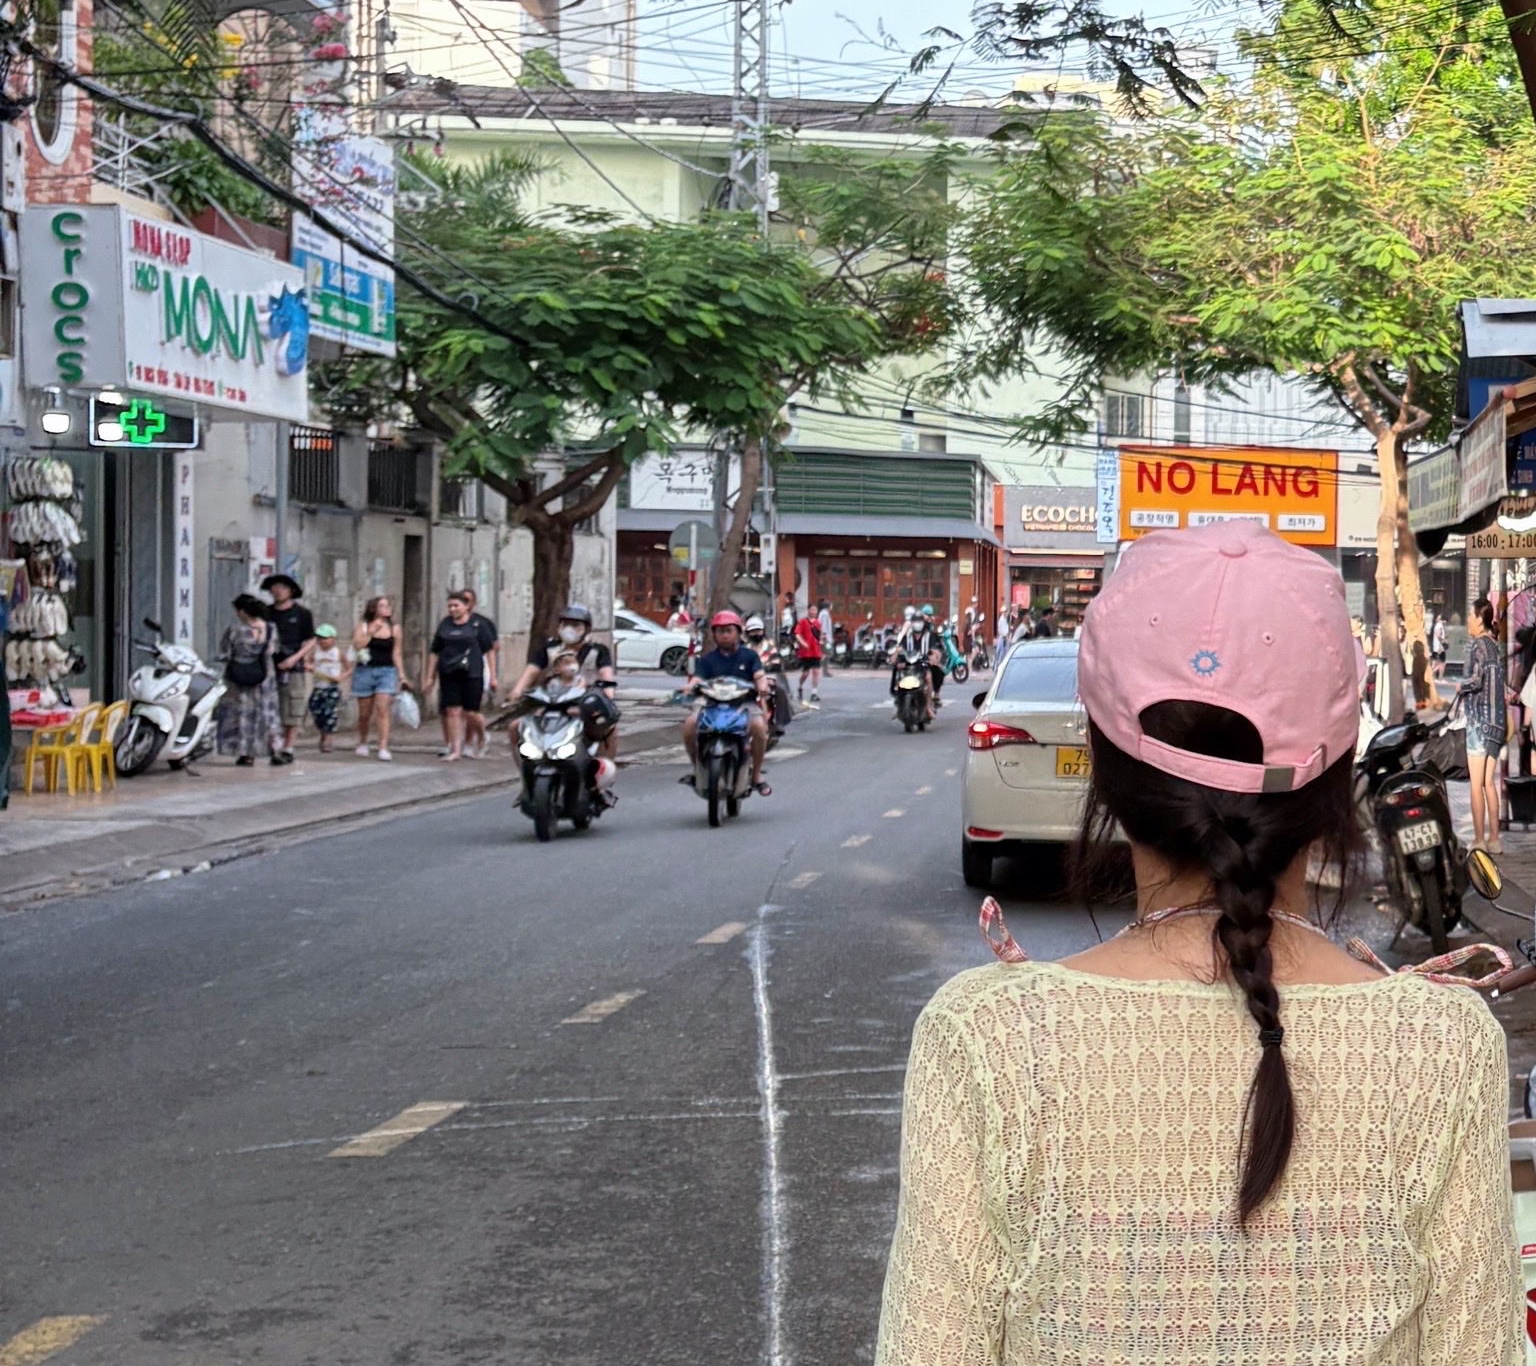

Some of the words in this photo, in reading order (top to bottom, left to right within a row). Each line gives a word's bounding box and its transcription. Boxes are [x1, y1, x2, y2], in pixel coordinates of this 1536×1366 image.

[162, 270, 264, 366] MONA
[1137, 461, 1195, 495] NO
[1211, 463, 1319, 498] LANG
[1021, 504, 1098, 523] ECOCH
[1472, 535, 1498, 548] 16:00
